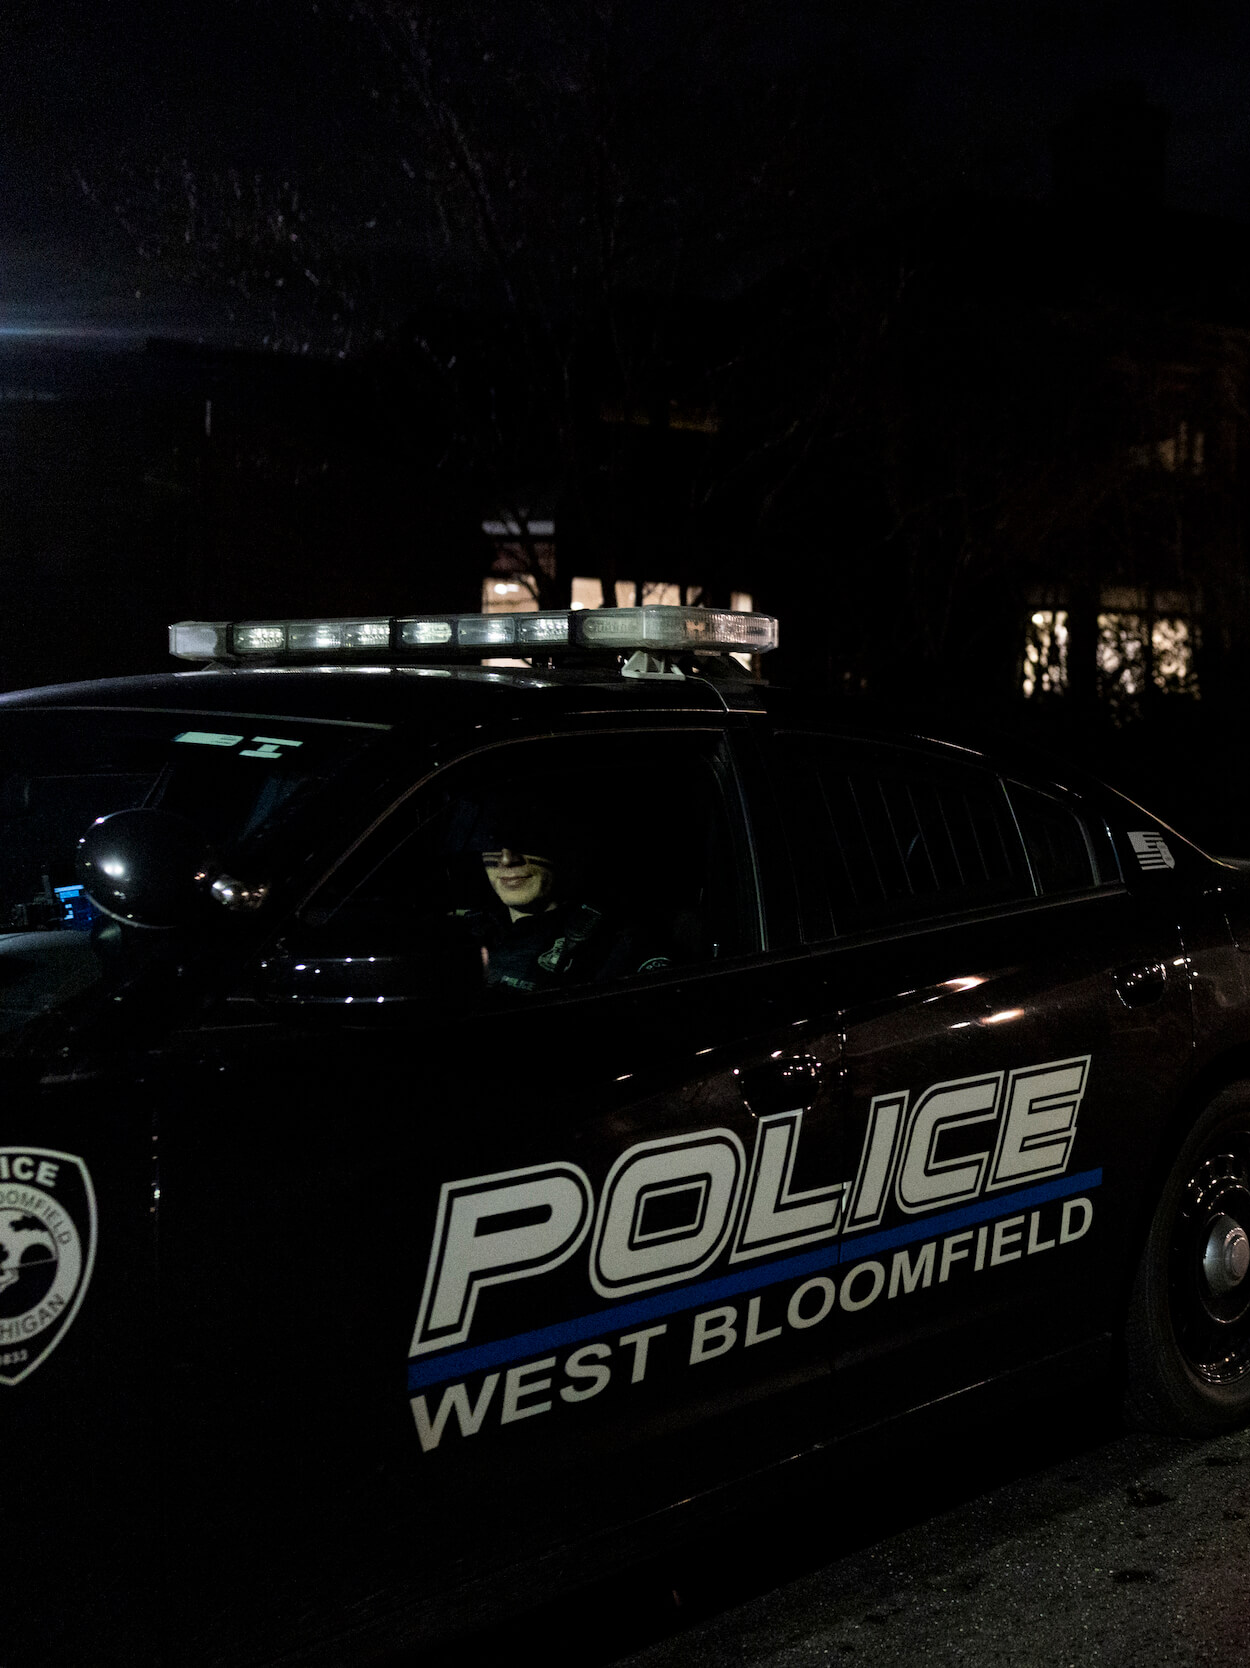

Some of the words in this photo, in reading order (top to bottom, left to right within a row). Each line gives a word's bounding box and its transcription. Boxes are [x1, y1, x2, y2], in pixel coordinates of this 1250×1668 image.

[408, 1055, 1092, 1358] POLICE
[411, 1324, 668, 1452] WEST
[690, 1198, 1093, 1366] BLOOMFIELD
